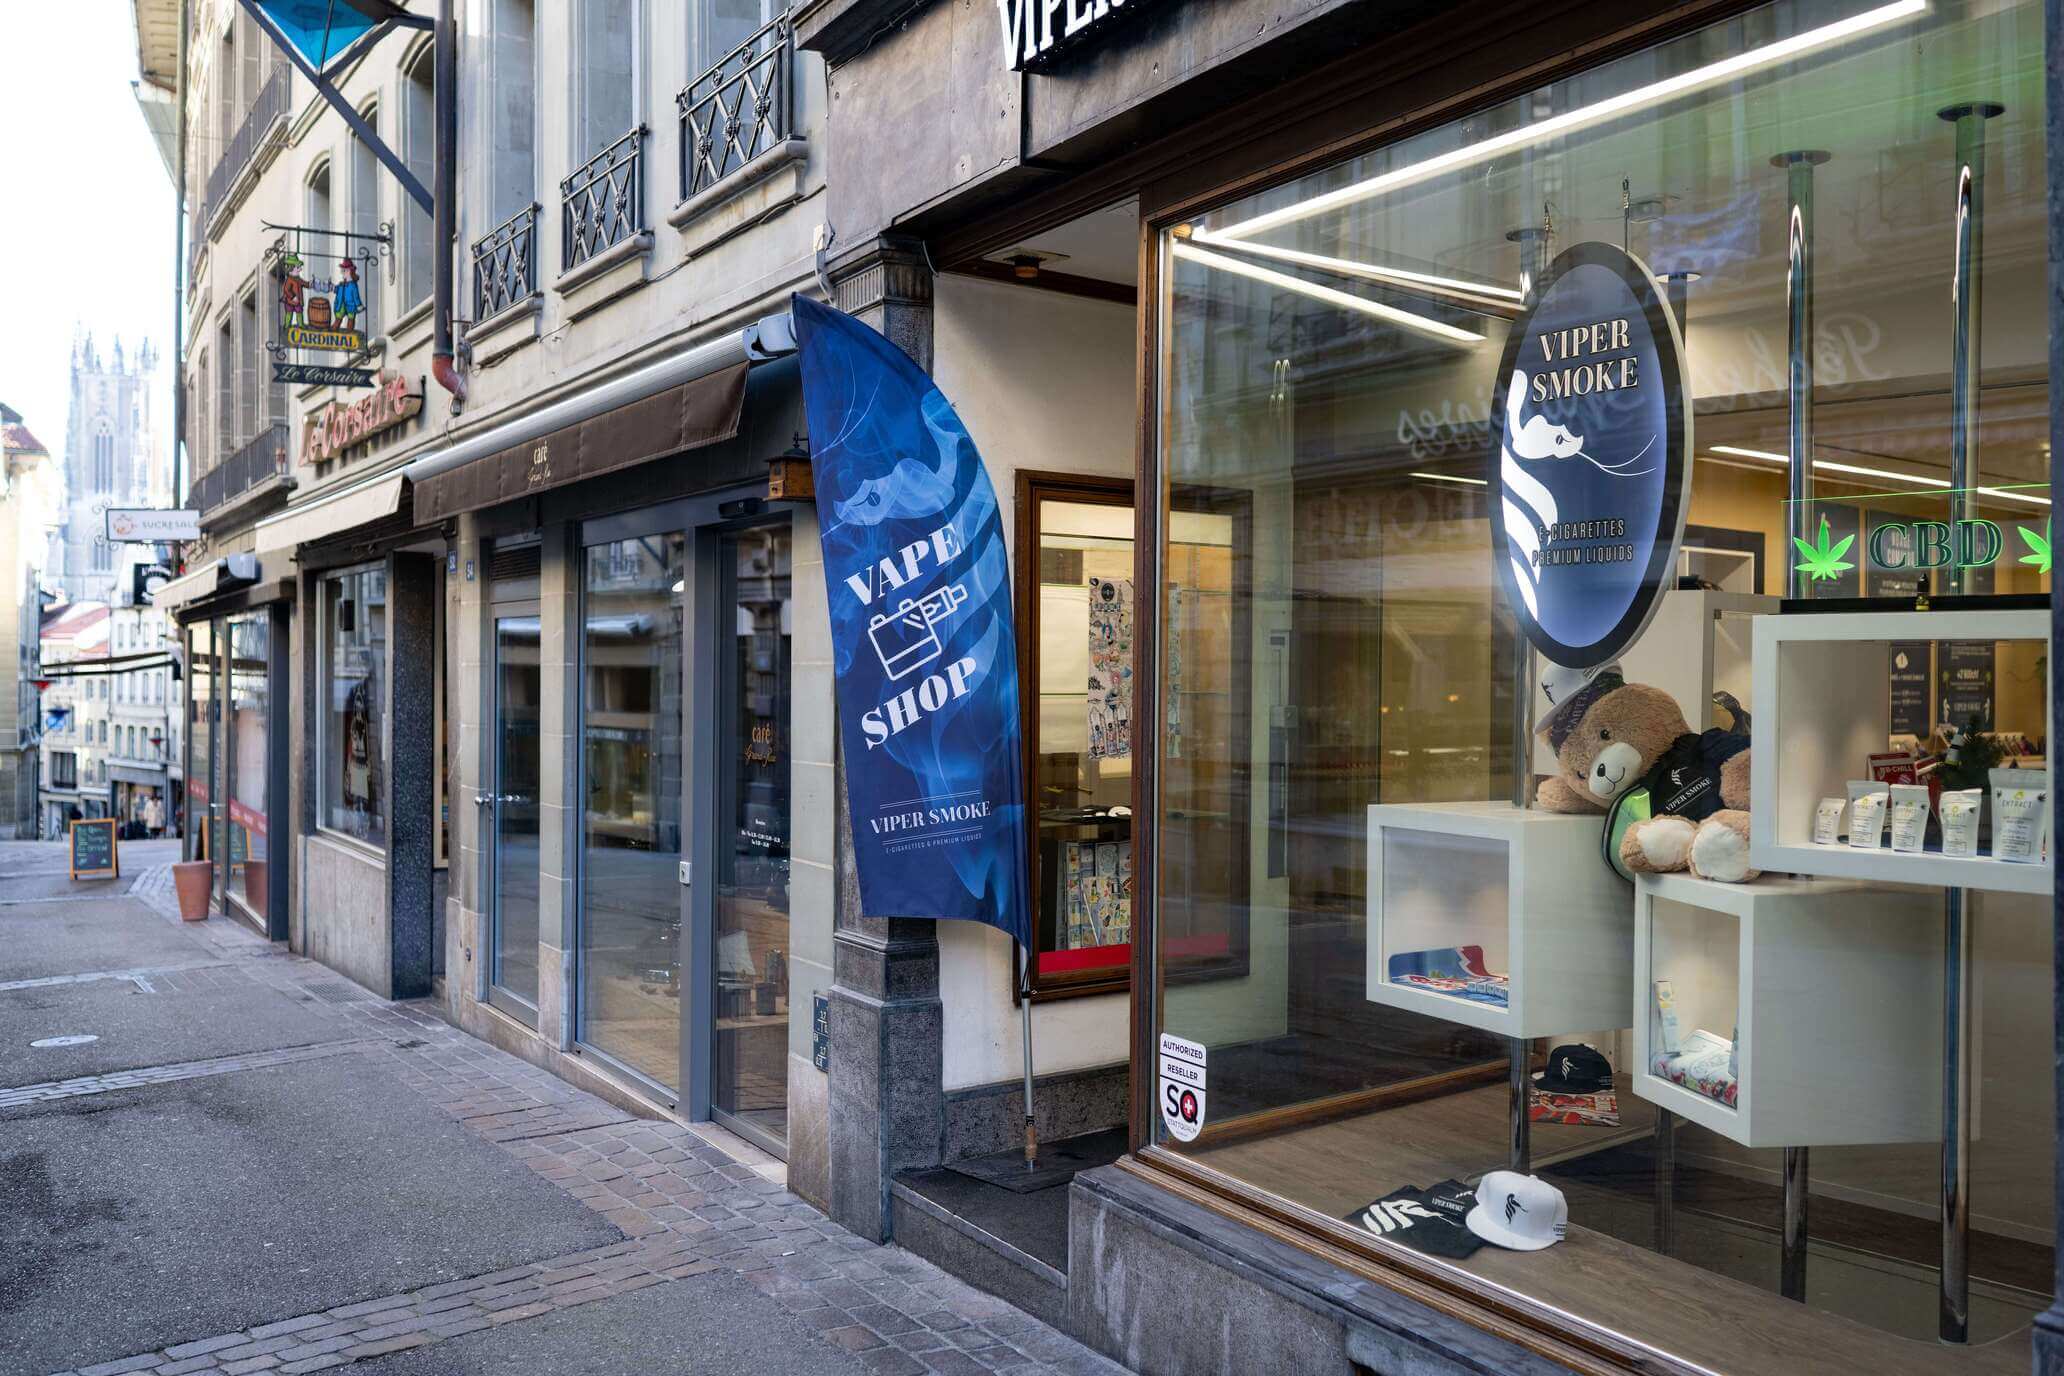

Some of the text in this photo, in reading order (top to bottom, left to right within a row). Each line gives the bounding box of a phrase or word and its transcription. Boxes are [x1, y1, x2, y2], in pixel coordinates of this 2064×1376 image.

[997, 0, 1125, 71] VIP
[289, 328, 357, 347] CARDINAL
[1538, 318, 1631, 363] VIPER
[281, 367, 366, 384] Le Corsaire
[1532, 356, 1640, 403] SMOKE
[298, 367, 409, 467] Le Corsaire
[1539, 520, 1625, 542] E-CIGARETTES
[1869, 519, 2004, 569] CBD
[844, 522, 964, 606] VAPE
[1532, 544, 1634, 567] PREMIUM LIQUIDS
[861, 656, 977, 750] SHOP
[1665, 777, 1713, 811] VIPER SMOKE
[870, 800, 992, 834] VIPER SMOKE
[1163, 1039, 1203, 1060] AUTHORIZED
[1167, 1064, 1199, 1081] RESELLER
